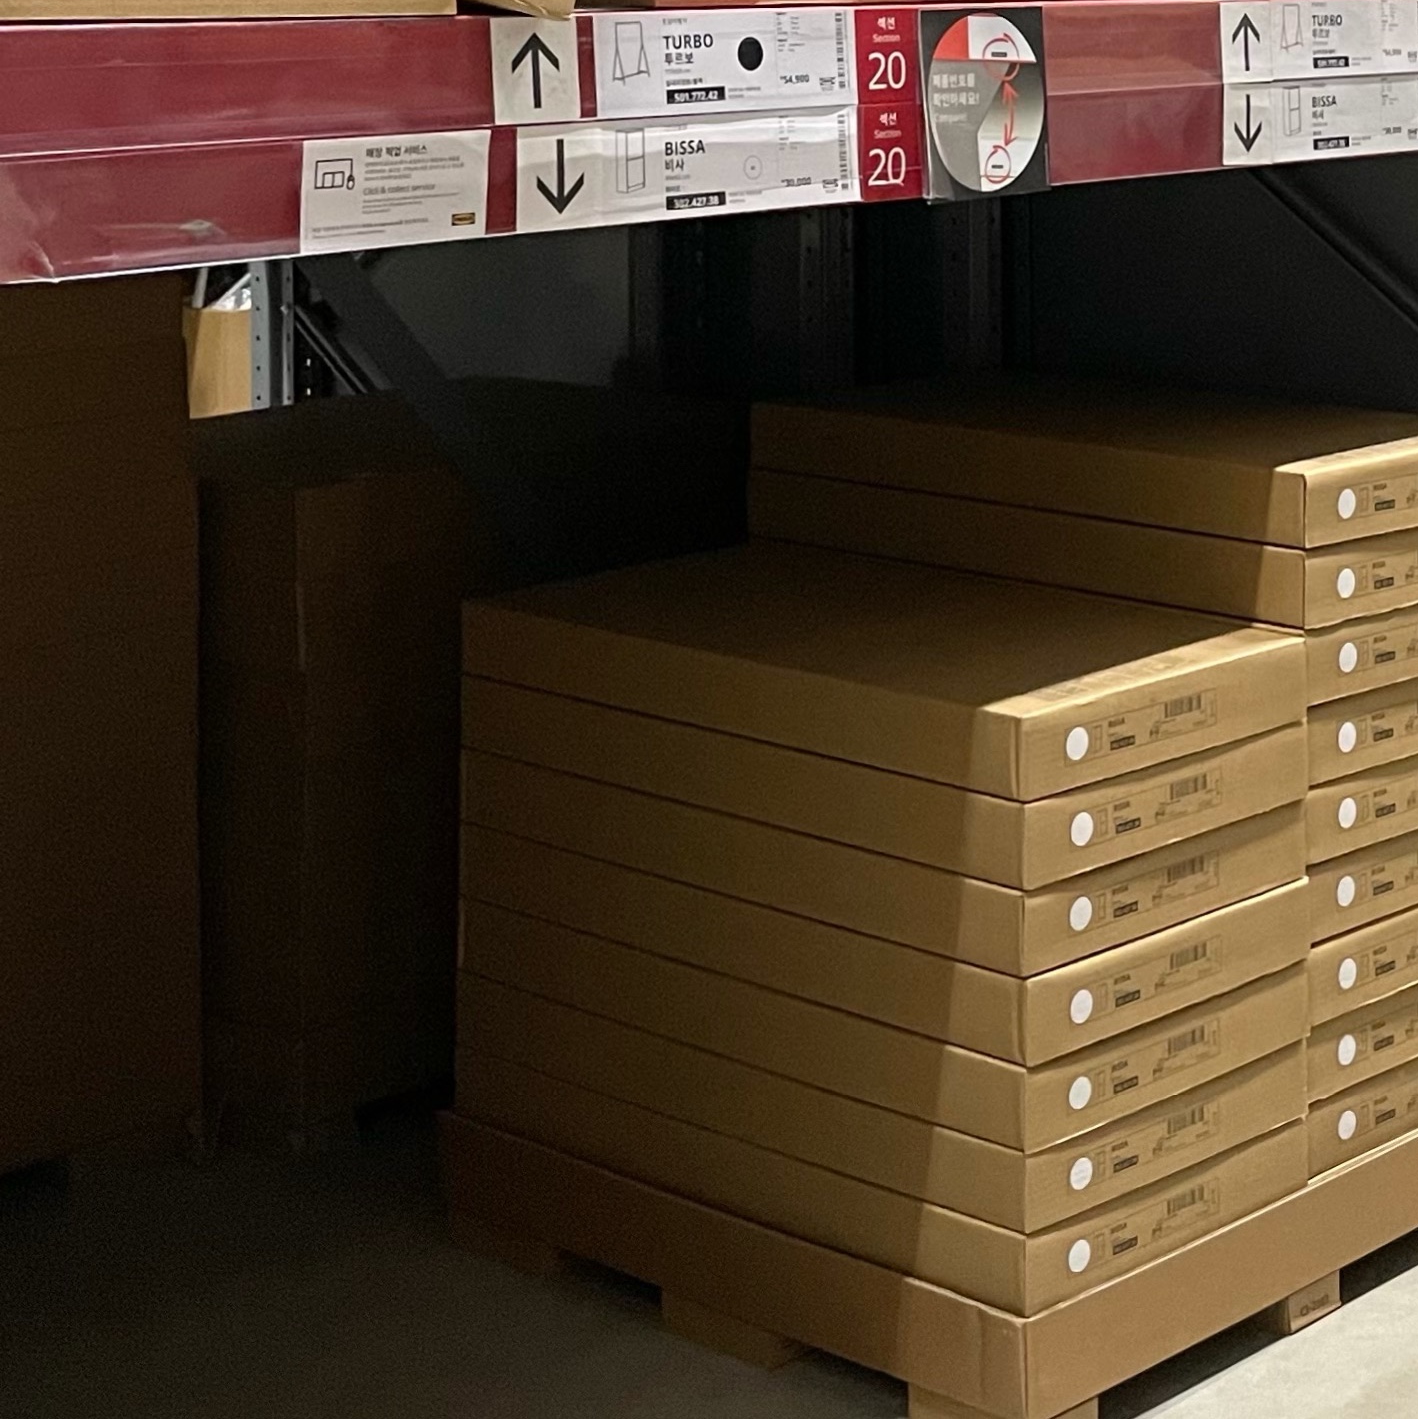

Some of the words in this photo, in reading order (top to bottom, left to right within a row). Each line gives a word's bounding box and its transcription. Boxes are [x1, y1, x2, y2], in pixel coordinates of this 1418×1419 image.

[877, 17, 895, 30] 섹션
[1312, 14, 1342, 27] TURBO
[663, 34, 713, 50] TURBO
[665, 52, 694, 65] 투르보
[868, 51, 906, 90] 20
[674, 90, 718, 103] 501.772.42
[1312, 95, 1337, 108] BISSA
[880, 112, 897, 126] 섹션
[665, 140, 706, 156] BISSA
[665, 158, 684, 171] 비사
[868, 147, 906, 187] 20
